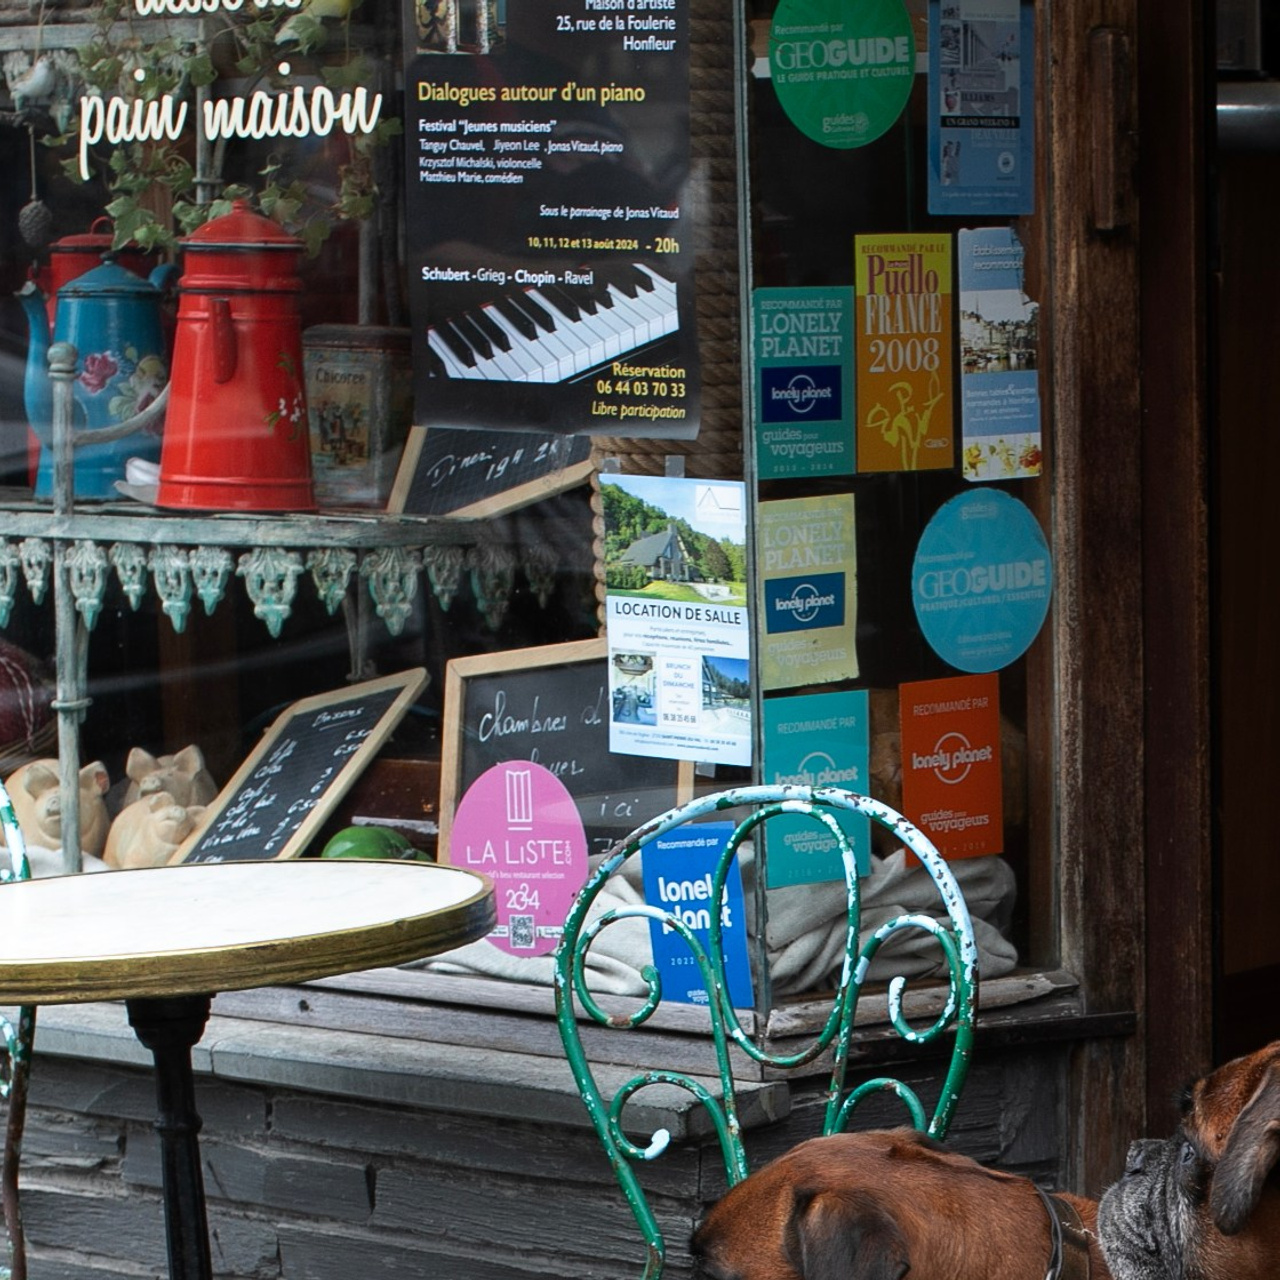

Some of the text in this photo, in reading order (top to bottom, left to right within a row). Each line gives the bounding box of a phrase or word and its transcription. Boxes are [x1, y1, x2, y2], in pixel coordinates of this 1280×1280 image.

[557, 15, 676, 32] 25, rue de la Foulerie
[831, 23, 843, 34] par
[623, 36, 676, 51] Honfleur
[775, 36, 910, 70] GEOGUIDE
[777, 67, 910, 83] LE GUIDE PRATIQUE ET CULTUREL
[418, 82, 645, 107] Dialogues autour d'un piano
[80, 61, 383, 181] pain maison
[419, 120, 457, 133] Festival
[419, 139, 447, 153] Tanguy
[450, 139, 485, 152] Chauvel,
[523, 140, 540, 151] Lee
[496, 158, 542, 170] violoncelle
[485, 172, 523, 184] comédien
[540, 204, 559, 216] Sous
[560, 205, 568, 217] le
[613, 205, 624, 217] de
[625, 205, 649, 219] Jonas
[650, 205, 679, 219] Vitaud
[528, 237, 542, 250] 10,
[544, 237, 557, 250] 11,
[582, 238, 593, 249] 13
[615, 238, 639, 251] 2024
[654, 237, 680, 254] 20h
[422, 267, 470, 282] Schubert
[514, 269, 556, 286] Chopin
[565, 270, 594, 285] Ravel
[867, 254, 939, 295] Pudlo
[826, 299, 842, 309] PAR
[865, 293, 942, 335] FRANCE
[760, 313, 843, 335] LONELY
[760, 335, 843, 358] PLANET
[869, 338, 940, 373] 2008
[613, 362, 685, 379] Réservation
[597, 381, 685, 397] 06 44 03 70 33
[772, 386, 832, 403] lonely planet
[592, 401, 685, 420] Libre participation
[762, 428, 802, 444] guides
[771, 440, 844, 460] voyageurs
[763, 521, 843, 548] LONELY
[765, 544, 845, 571] PLANET
[919, 559, 1046, 600] GEOGUIDE
[776, 594, 835, 612] lonely planet
[615, 602, 741, 625] LOCATION DE SALLE
[913, 697, 988, 716] RECOMMANDÉ PAR
[777, 717, 856, 734] RECOMMANDÉ PAR
[912, 745, 992, 772] lonely planet
[921, 809, 953, 825] guides
[929, 813, 990, 833] voyageurs
[656, 838, 719, 850] Recommandé par
[784, 830, 818, 845] guides
[793, 836, 856, 853] voyages
[466, 840, 497, 864] LA
[662, 904, 733, 936] plant
[671, 957, 695, 966] 2022
